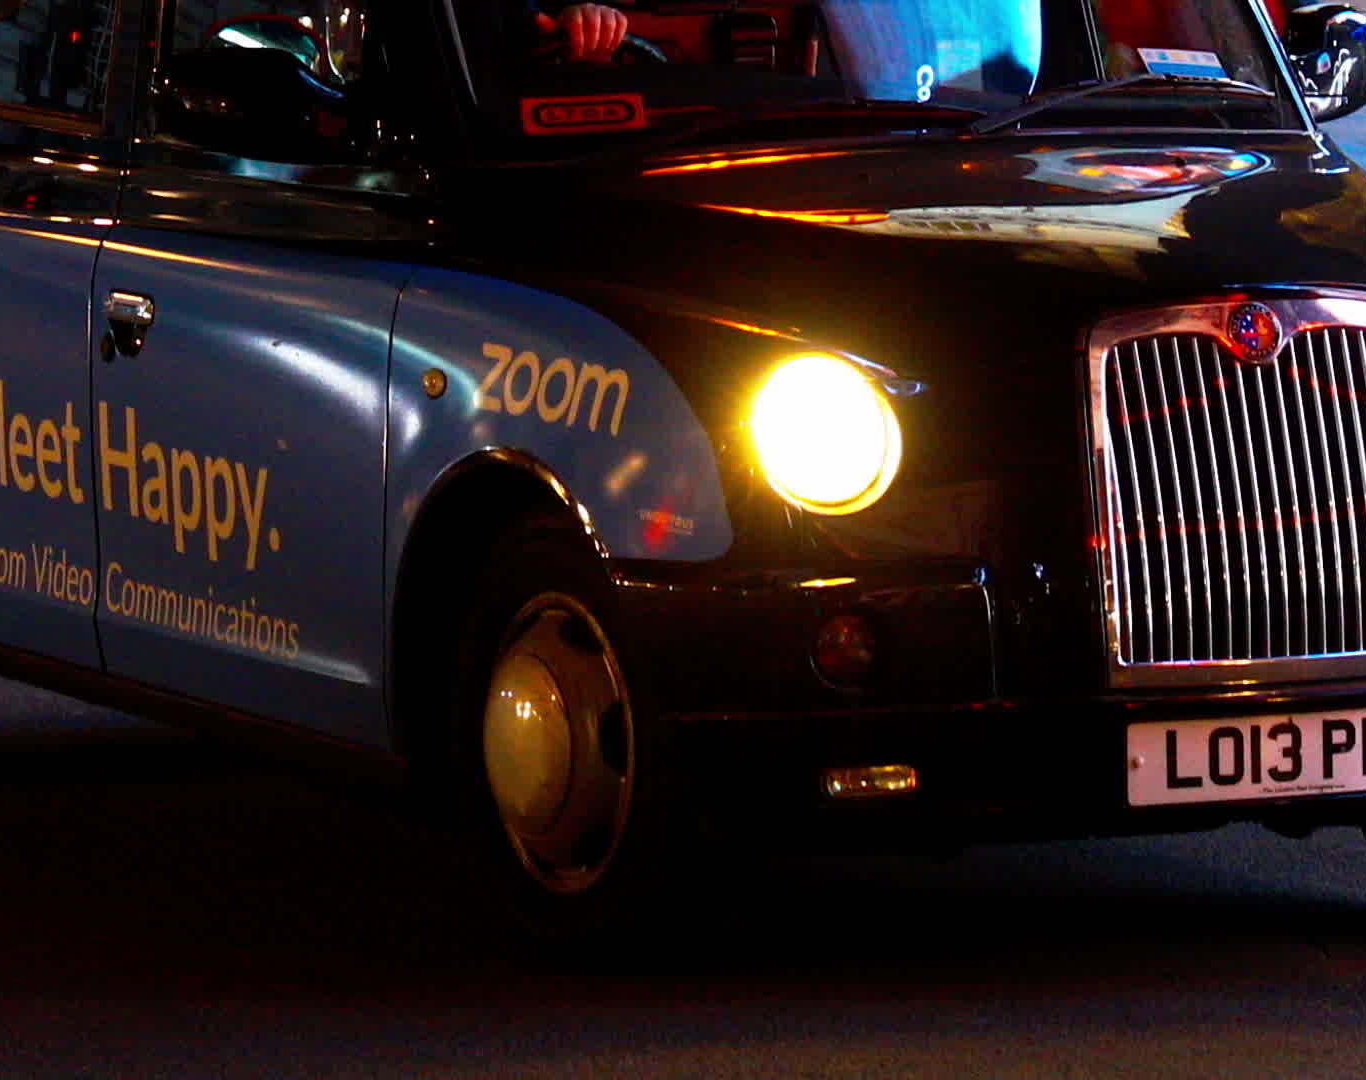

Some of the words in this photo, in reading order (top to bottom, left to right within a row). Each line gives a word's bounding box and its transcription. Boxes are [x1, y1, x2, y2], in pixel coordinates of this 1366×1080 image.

[476, 341, 632, 437] zoom
[98, 400, 281, 571] Happy.
[31, 542, 93, 606] Video
[105, 560, 300, 659] Communications
[1165, 721, 1303, 789] LO13
